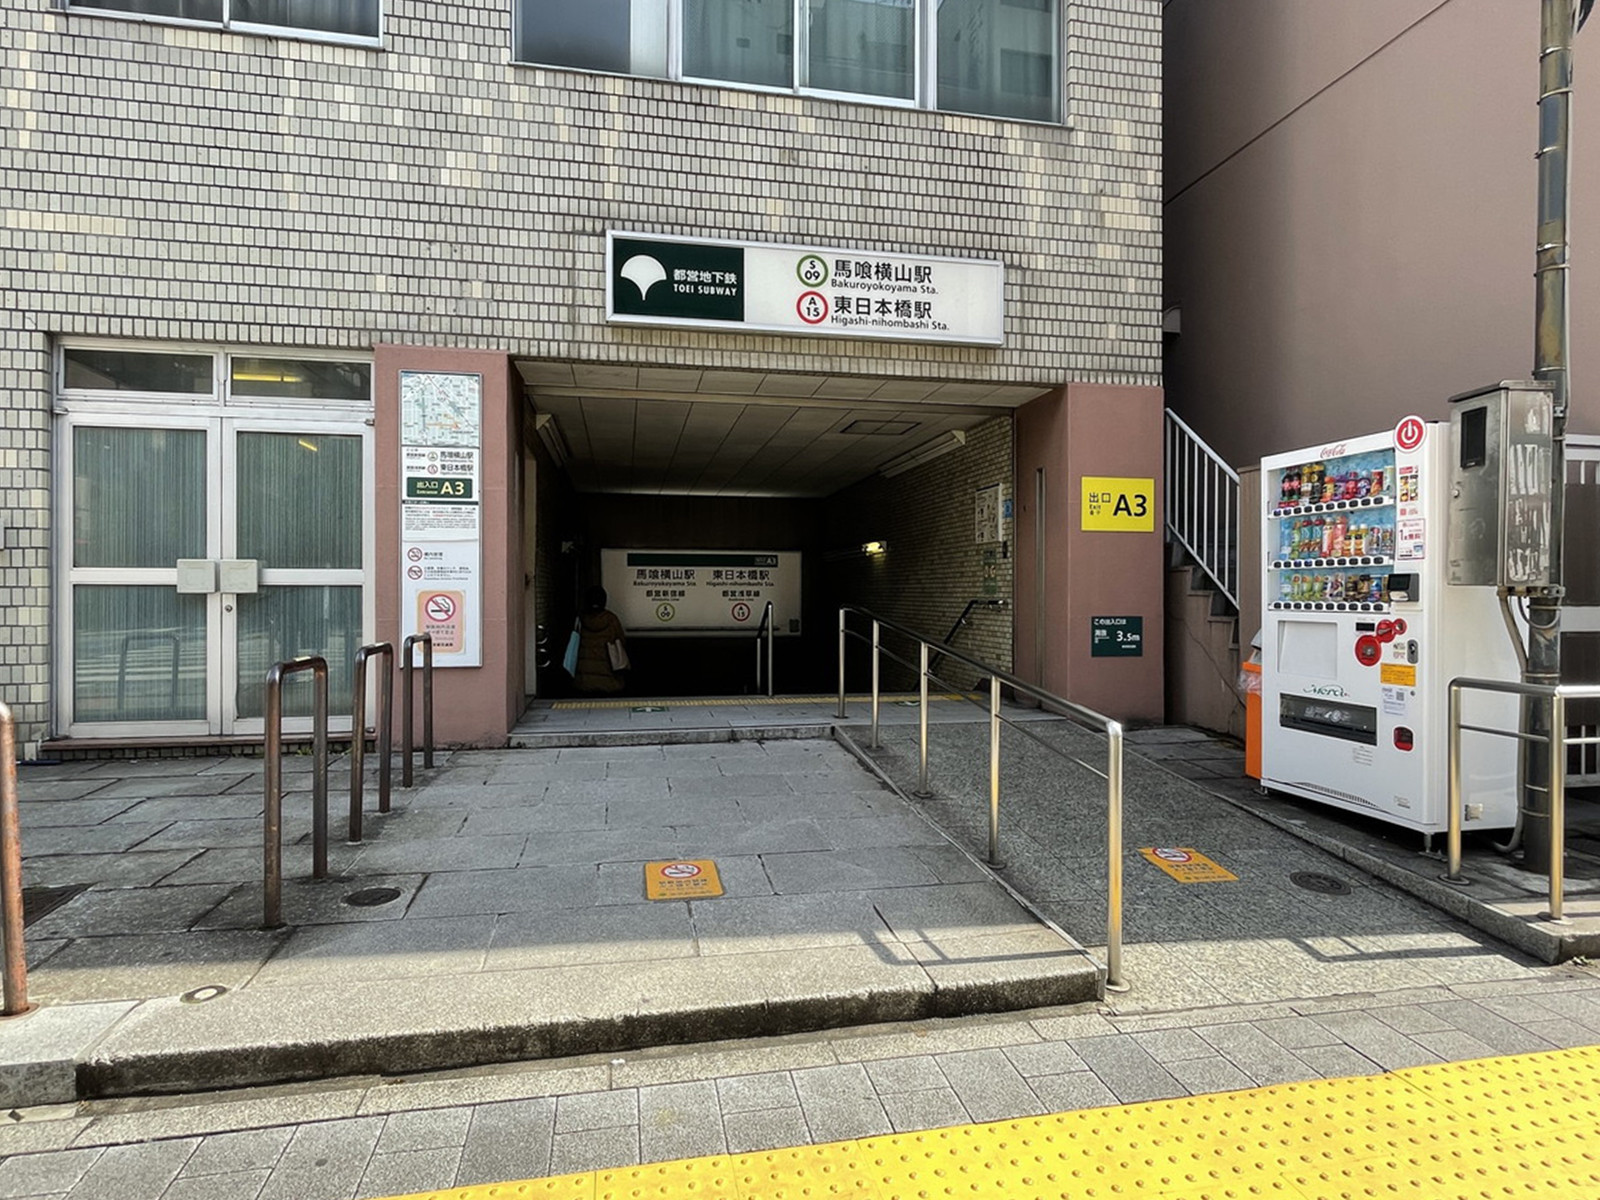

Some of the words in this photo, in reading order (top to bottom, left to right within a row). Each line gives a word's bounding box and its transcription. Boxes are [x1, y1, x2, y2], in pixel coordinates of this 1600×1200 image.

[809, 260, 816, 270] S
[833, 259, 932, 284] 馬喰横山駅
[673, 269, 738, 285] 都営地下鉄
[804, 270, 820, 281] 09
[673, 283, 694, 294] TOEI
[697, 285, 737, 297] SUBWAY
[831, 278, 918, 294] Bakuroyokoyama
[920, 284, 939, 295] Sta.
[808, 297, 817, 306] A
[833, 295, 932, 319] 東日本橋駅
[805, 307, 820, 318] 15
[831, 315, 929, 329] Higashi-nihombashi
[931, 321, 950, 331] Sta.
[440, 481, 465, 495] A3
[1089, 492, 1111, 503] 出口
[1112, 494, 1147, 517] A3
[712, 569, 770, 580] 東日本橋駅
[1116, 630, 1141, 642] 3.5m
